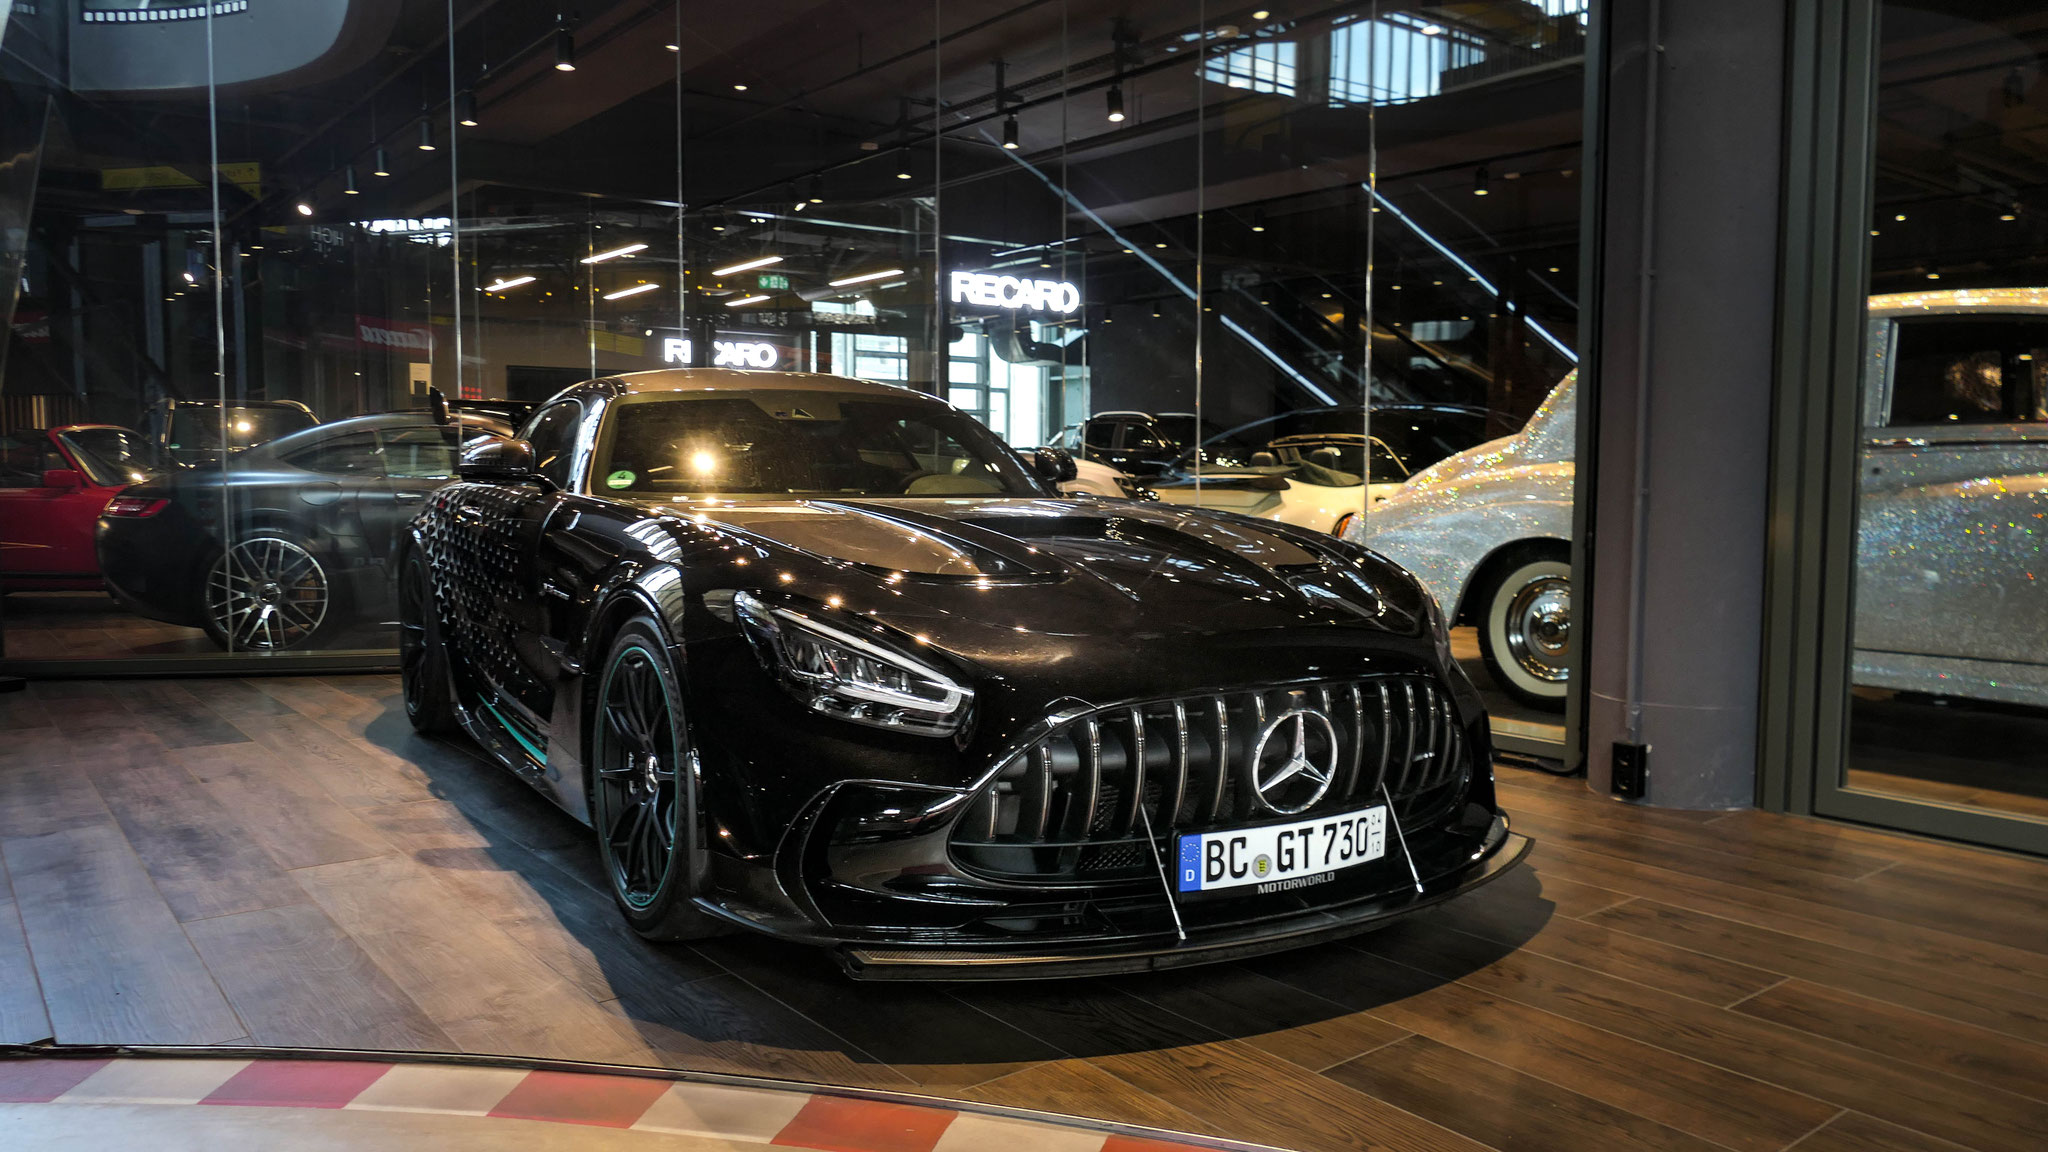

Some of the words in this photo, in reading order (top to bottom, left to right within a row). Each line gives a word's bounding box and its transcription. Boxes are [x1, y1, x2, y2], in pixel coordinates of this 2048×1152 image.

[951, 270, 1081, 314] RECARO
[1206, 836, 1248, 883] BC
[1277, 827, 1314, 872] GT
[1323, 817, 1369, 865] 730
[1184, 869, 1196, 882] D
[1257, 871, 1336, 895] MOTORWORLD
